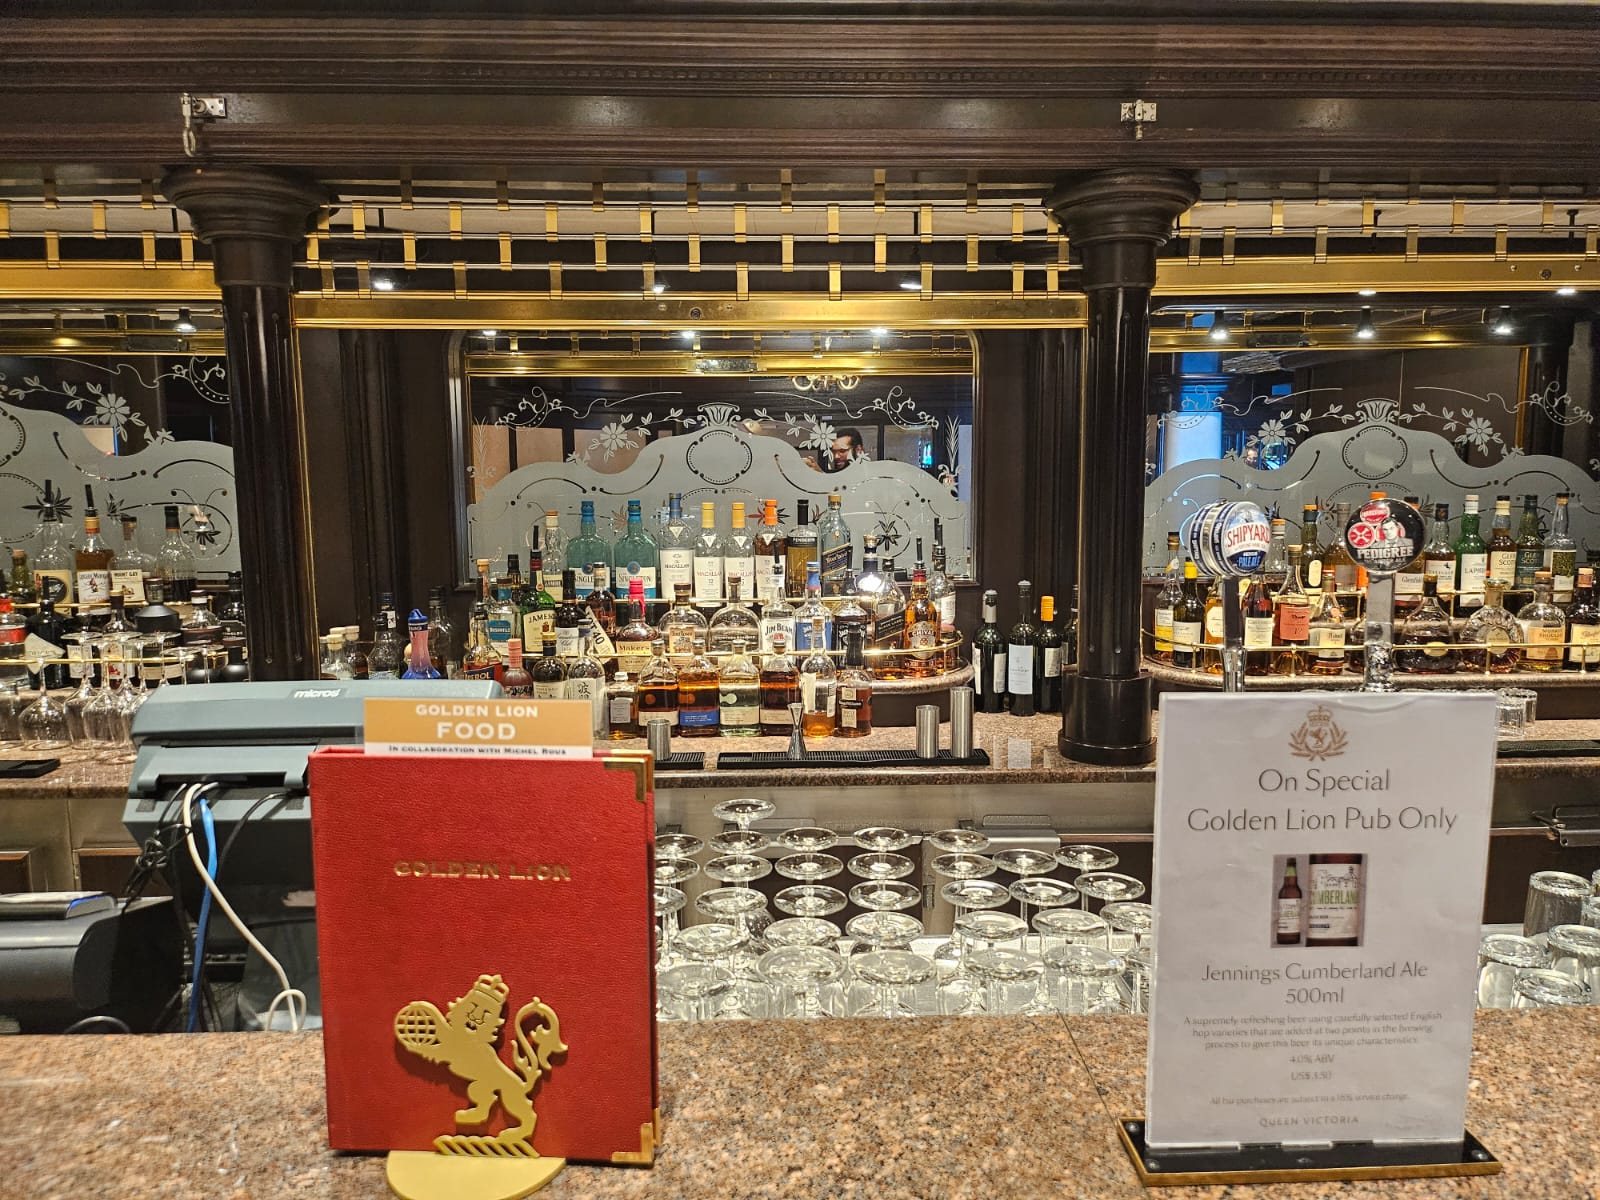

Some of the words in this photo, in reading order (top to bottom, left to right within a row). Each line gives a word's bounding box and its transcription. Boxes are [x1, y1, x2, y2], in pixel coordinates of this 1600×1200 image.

[1227, 524, 1270, 548] SHIPYARD
[1357, 546, 1414, 559] PEDIGREE
[765, 625, 776, 636] JIM
[777, 623, 793, 633] BEAM
[294, 688, 341, 698] micros
[416, 704, 488, 717] GOLDEN
[496, 706, 538, 718] LION
[437, 722, 516, 740] FOOD
[1258, 768, 1298, 792] On
[1305, 768, 1391, 797] Special
[1187, 808, 1277, 831] Golden
[1286, 808, 1336, 830] Lion
[1345, 806, 1391, 829] Pub
[1399, 805, 1457, 835] Only
[393, 861, 500, 879] GOLDEN
[509, 864, 572, 881] LION
[1201, 964, 1280, 985] Jennings
[1285, 962, 1396, 980] Cumberland
[1400, 961, 1428, 977] Ale
[1285, 986, 1344, 1004] 500ml
[1192, 1016, 1239, 1027] supremely
[1287, 1014, 1306, 1024] beer
[1373, 1012, 1408, 1021] selected
[1410, 1011, 1442, 1021] English
[1193, 1028, 1210, 1039] hop
[1250, 1027, 1267, 1036] that
[1382, 1024, 1397, 1033] the
[1290, 1039, 1309, 1047] beer
[1314, 1053, 1335, 1063] ABV
[1259, 1117, 1299, 1127] QUEEN
[1303, 1115, 1360, 1125] VICTORIA
